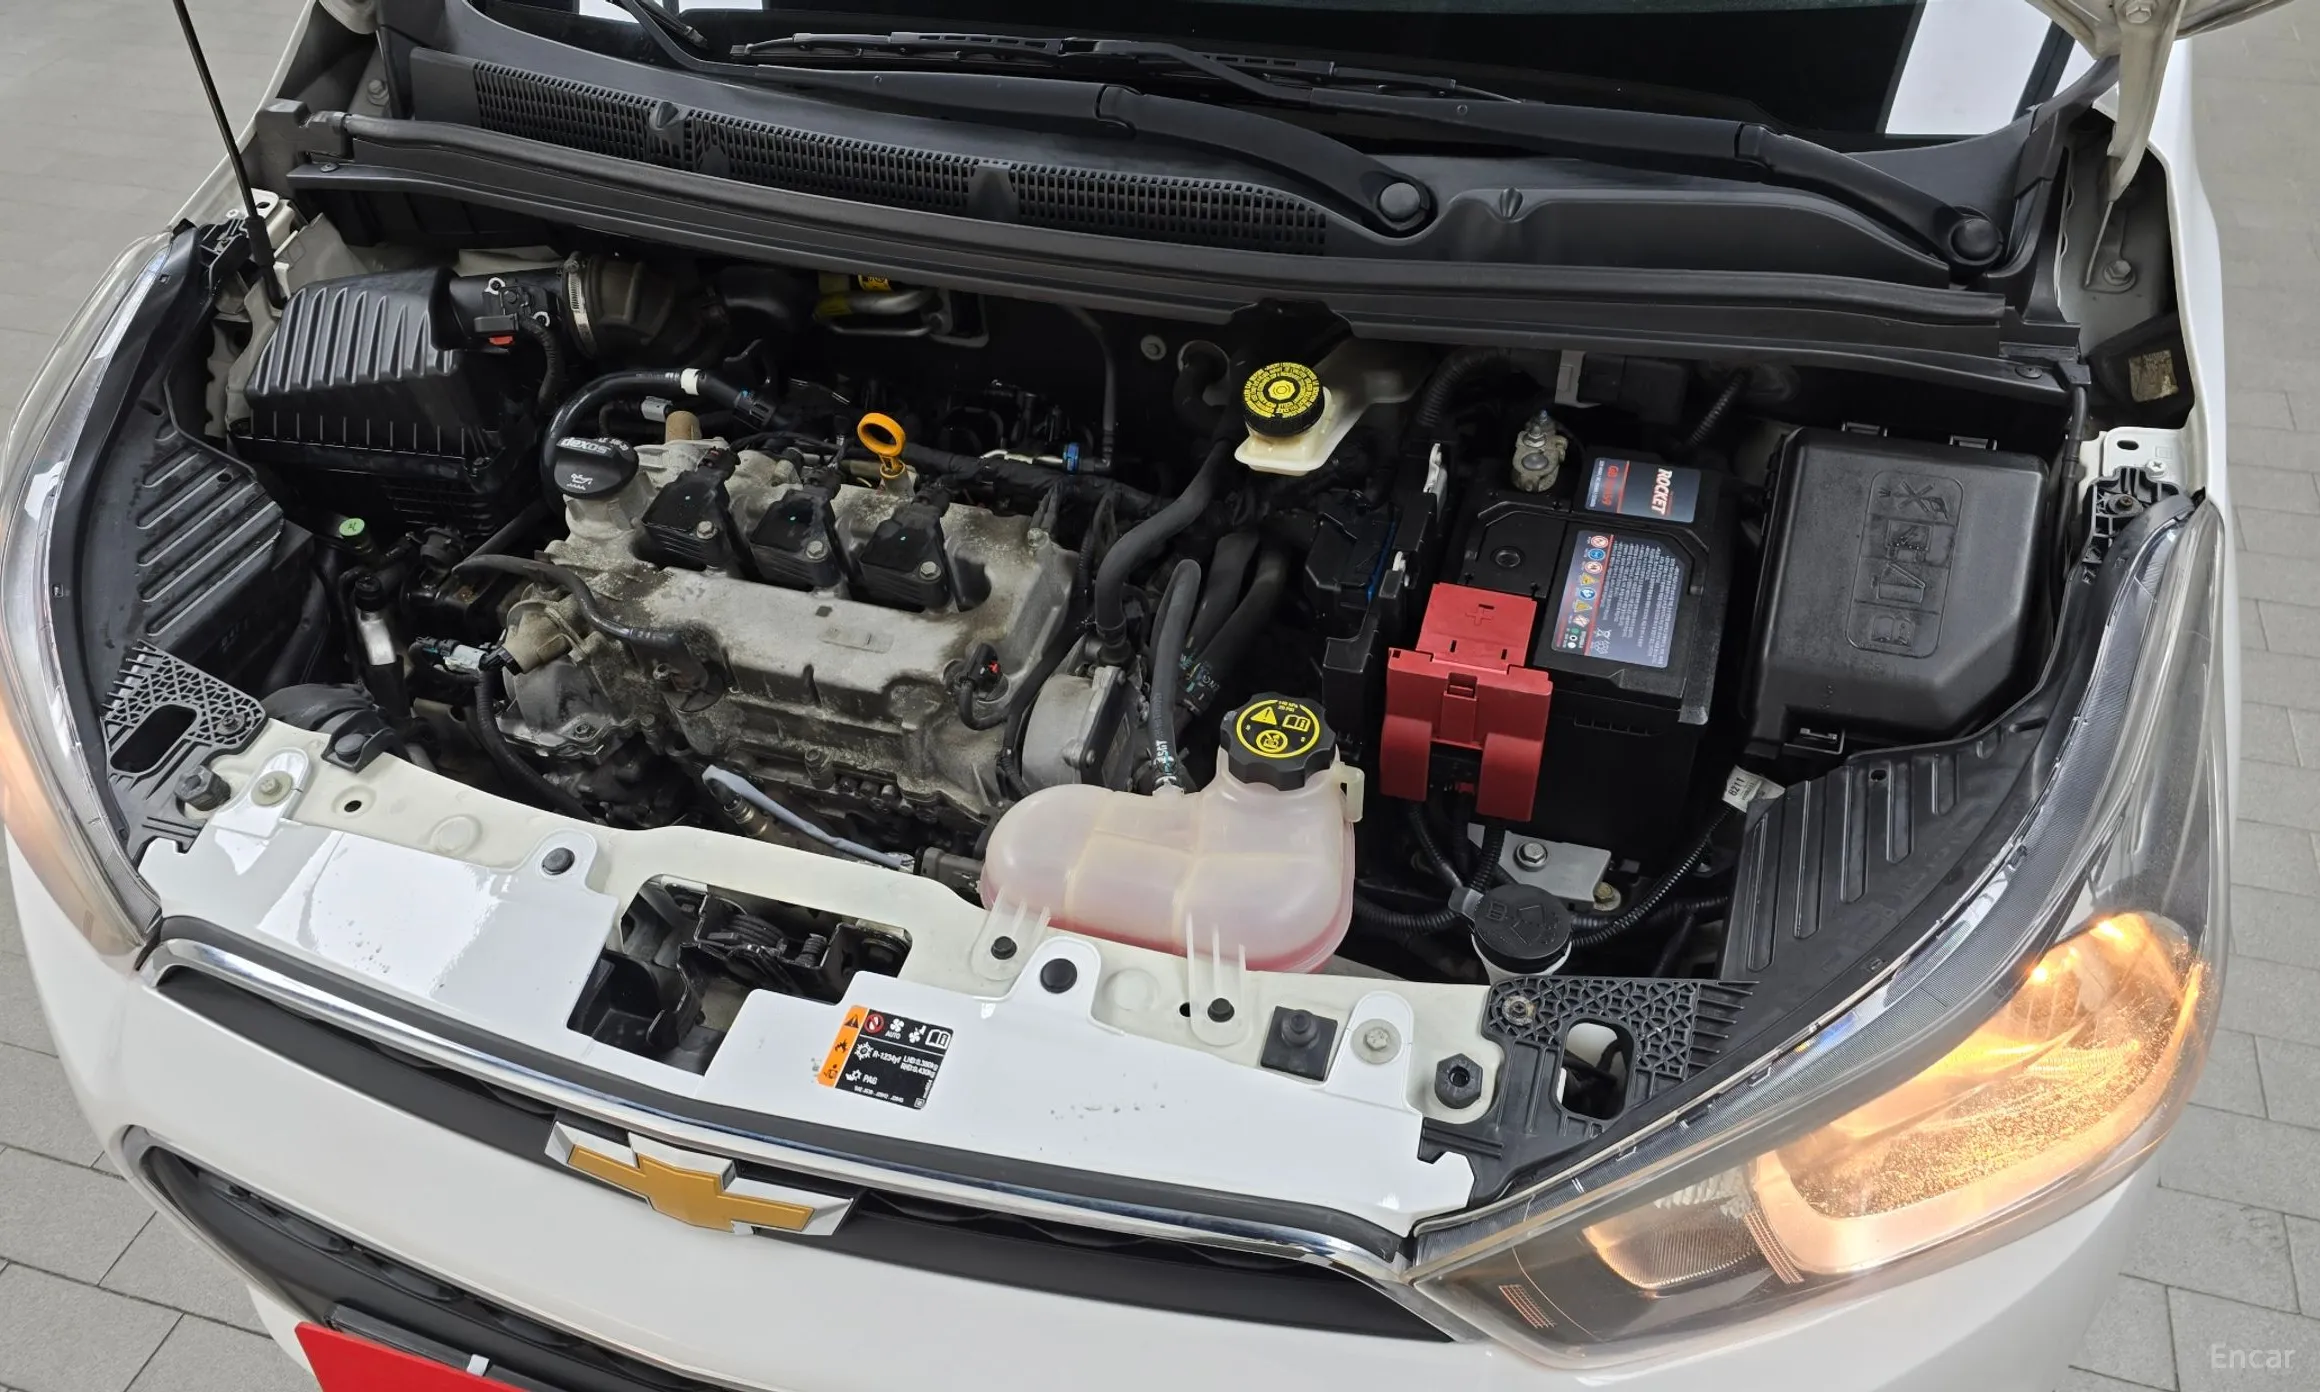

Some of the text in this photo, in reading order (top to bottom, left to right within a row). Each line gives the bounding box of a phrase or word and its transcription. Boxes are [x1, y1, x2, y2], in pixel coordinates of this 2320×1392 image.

[1651, 467, 1672, 515] ROCKET
[885, 1031, 901, 1039] AUTO
[862, 1074, 878, 1085] PAG
